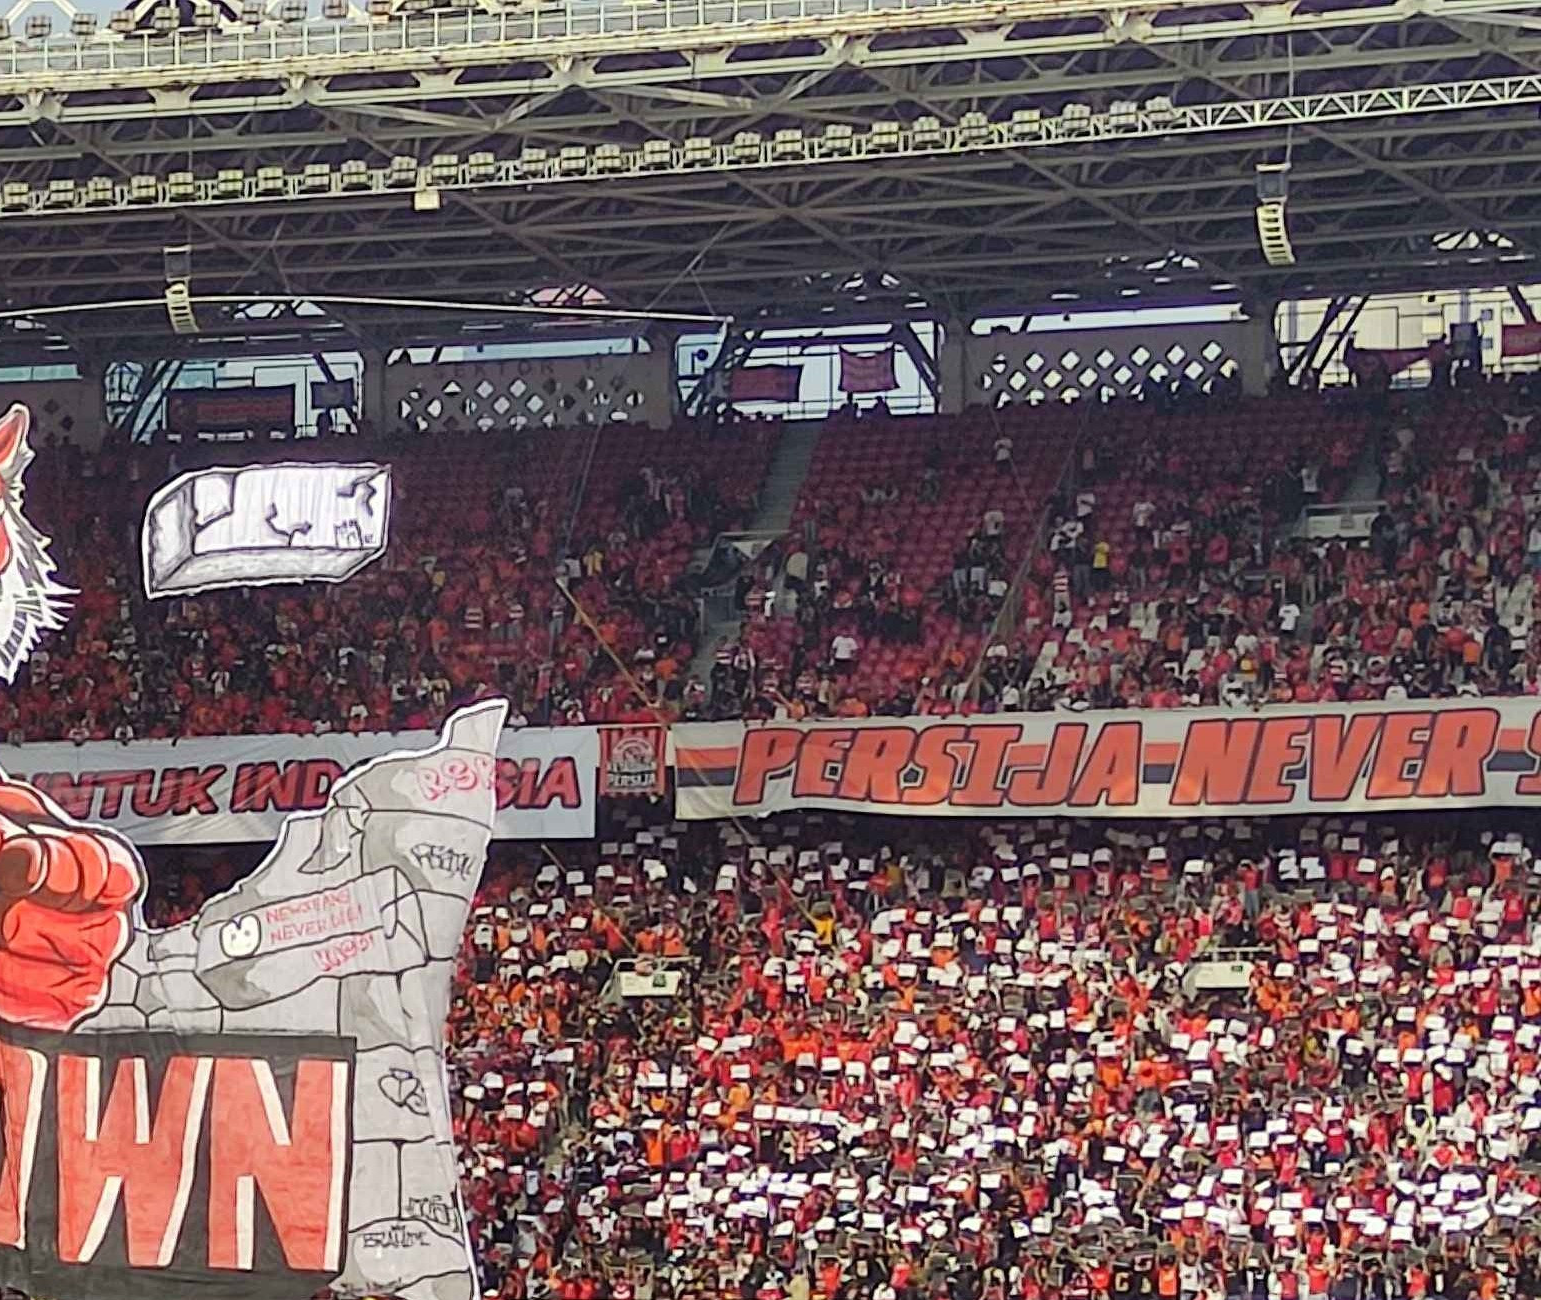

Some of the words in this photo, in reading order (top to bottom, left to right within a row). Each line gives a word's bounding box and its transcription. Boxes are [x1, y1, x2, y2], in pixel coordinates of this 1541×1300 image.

[10, 764, 227, 820] NTUK
[731, 720, 1143, 808] PERSIJA
[1170, 707, 1501, 805] NEVER
